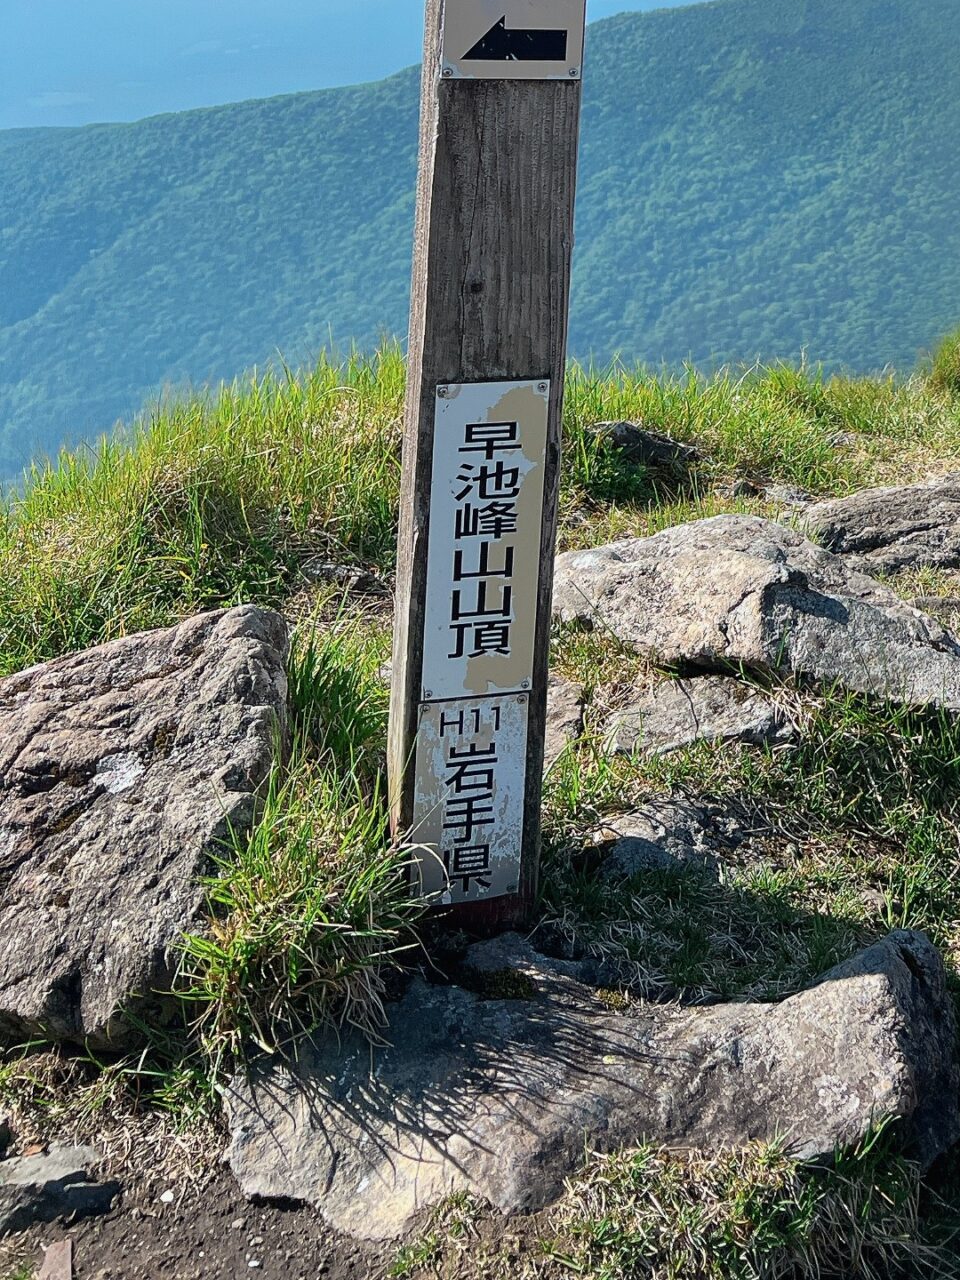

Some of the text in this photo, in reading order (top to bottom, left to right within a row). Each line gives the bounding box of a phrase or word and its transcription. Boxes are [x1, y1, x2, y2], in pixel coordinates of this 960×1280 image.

[447, 421, 522, 659] 早池峰山山頂
[440, 706, 501, 738] H11
[442, 742, 498, 893] 岩手県
